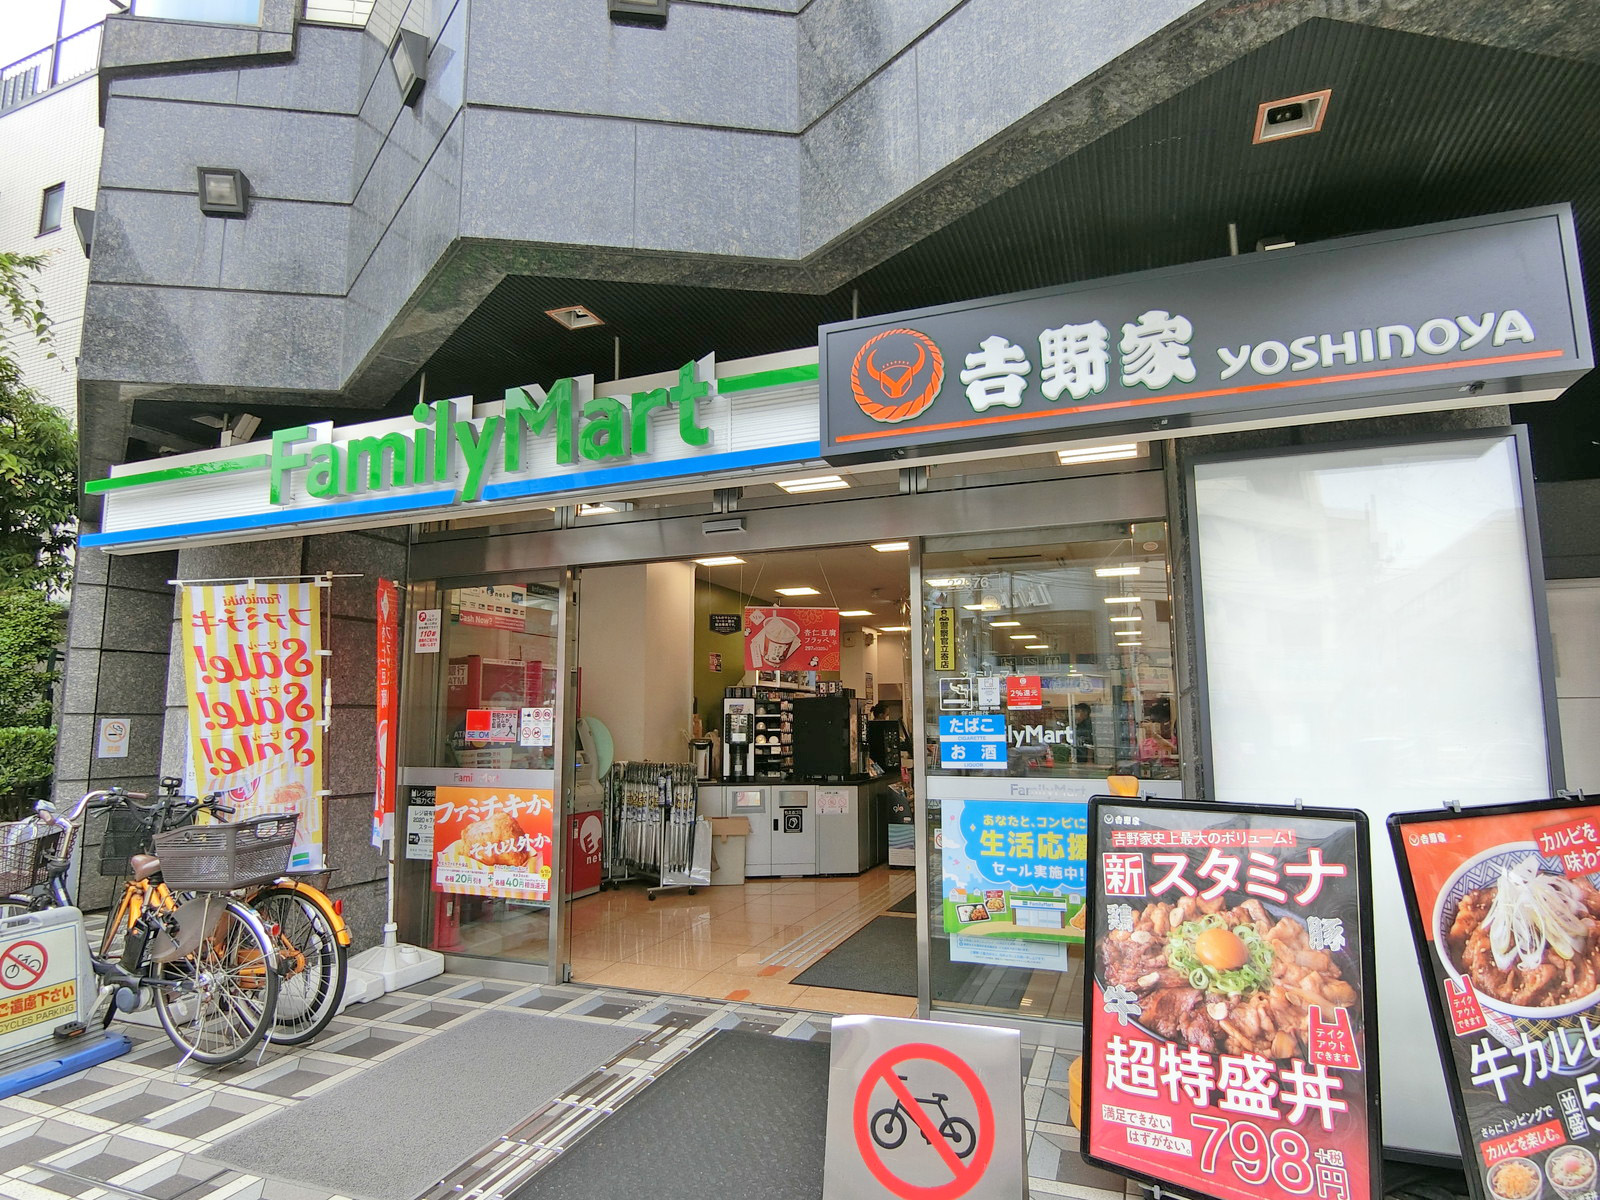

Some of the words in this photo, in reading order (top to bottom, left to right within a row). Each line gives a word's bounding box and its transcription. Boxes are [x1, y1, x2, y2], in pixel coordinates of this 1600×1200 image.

[270, 359, 713, 504] FamilyMart
[467, 730, 490, 739] SEOM
[949, 718, 995, 733] たばこ
[1539, 822, 1598, 853] カルビを
[36, 1003, 74, 1022] PARKING
[1103, 984, 1142, 1027] 牛
[1315, 1027, 1345, 1040] テイク
[1315, 1040, 1346, 1051] アウト
[1314, 1050, 1352, 1064] できます
[1105, 1035, 1349, 1131] 超特盛丼
[1103, 1105, 1171, 1130] 満足できない
